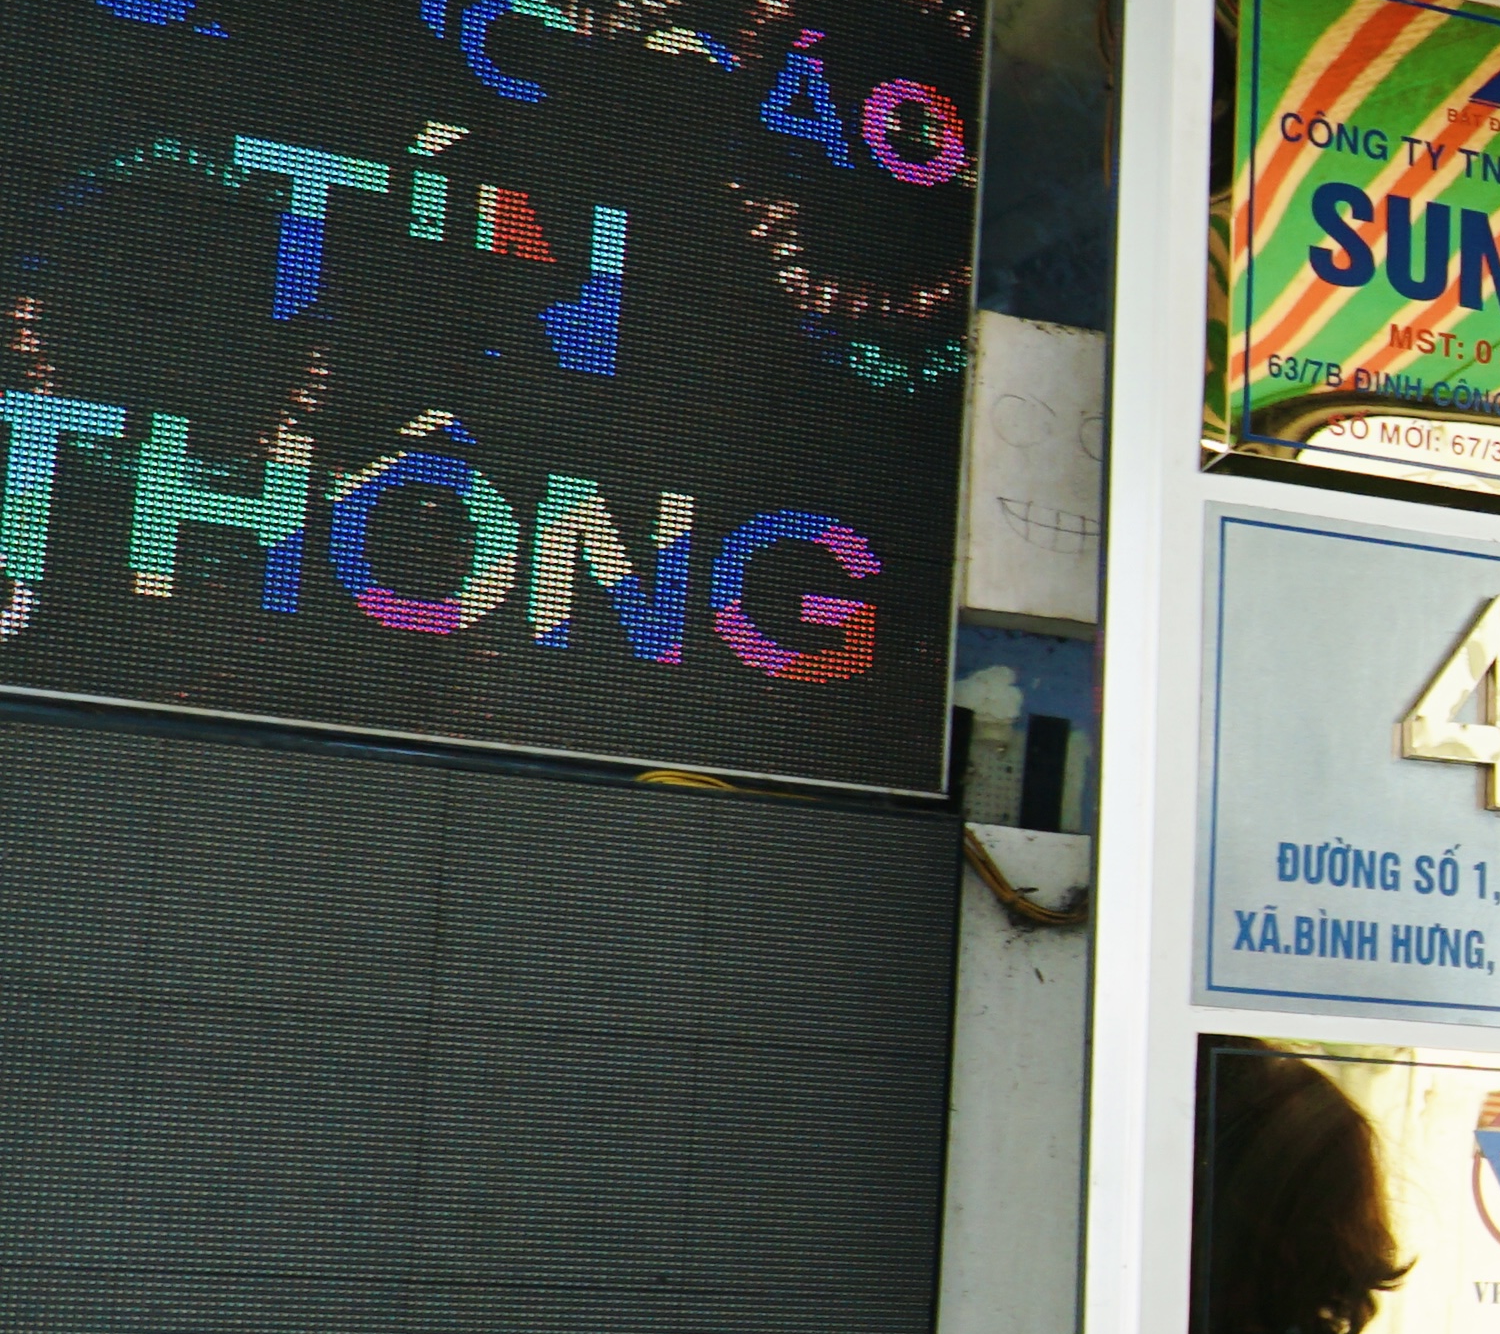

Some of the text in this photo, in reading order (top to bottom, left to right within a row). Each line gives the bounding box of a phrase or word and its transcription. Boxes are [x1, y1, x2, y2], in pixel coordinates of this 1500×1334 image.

[1281, 110, 1388, 162] CÔNG
[1401, 135, 1446, 171] TY
[1327, 409, 1370, 440] SỐ
[1380, 419, 1441, 454] MỚI:
[1276, 838, 1401, 893] ĐƯỜNG
[1414, 843, 1462, 899] SỐ
[1233, 906, 1378, 963] XÃ.BÌNH
[1390, 923, 1495, 978] HƯNG,
